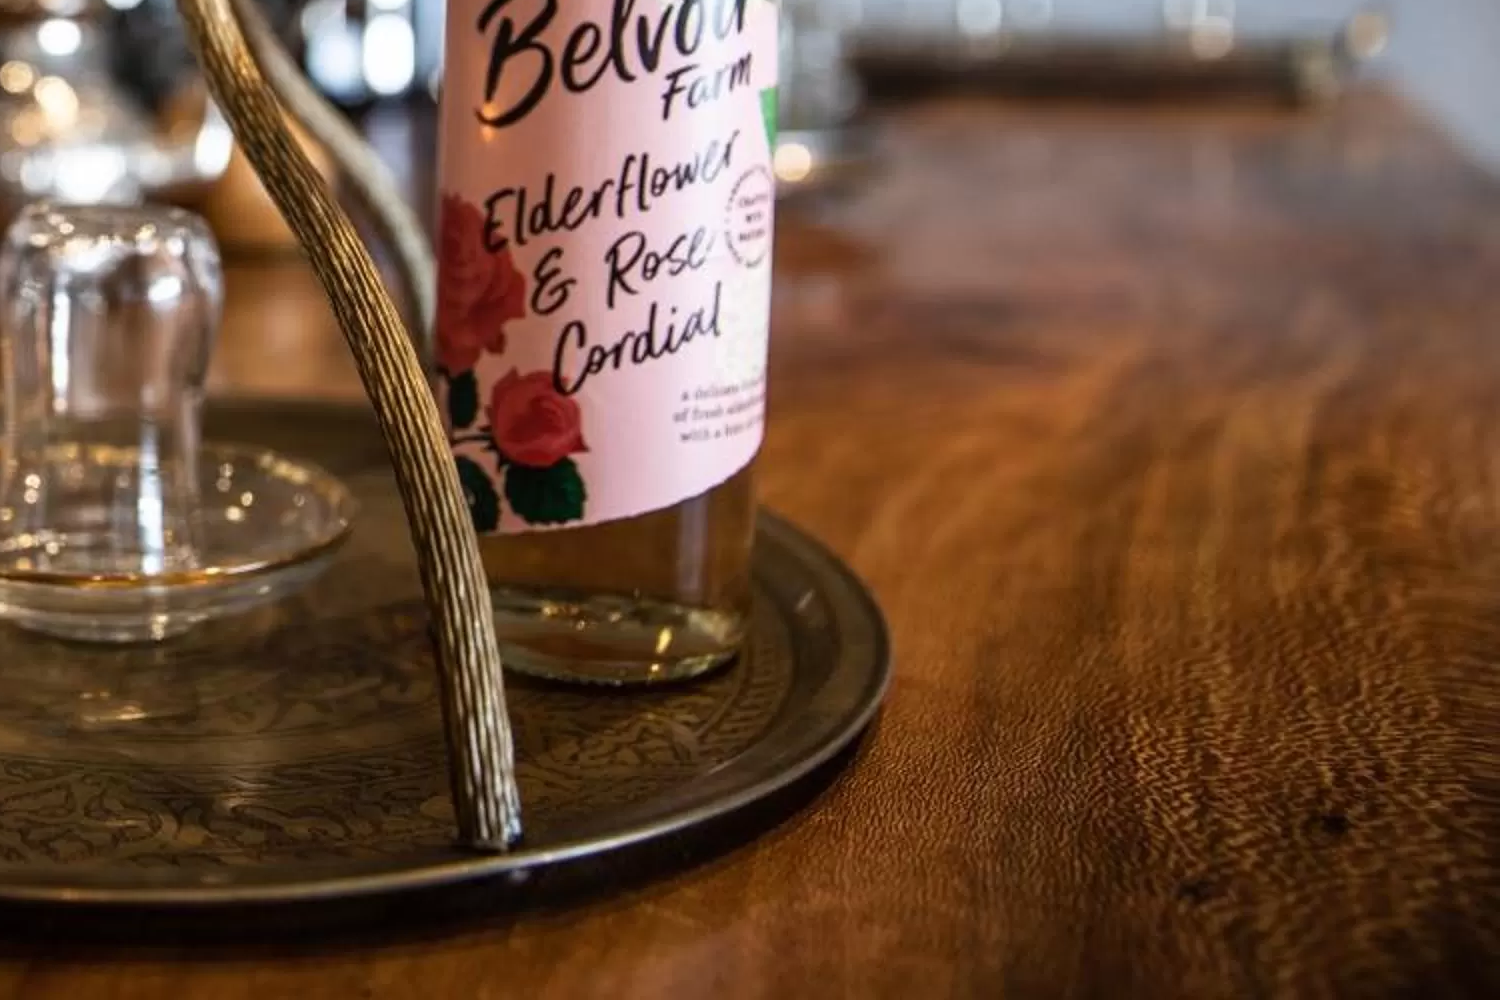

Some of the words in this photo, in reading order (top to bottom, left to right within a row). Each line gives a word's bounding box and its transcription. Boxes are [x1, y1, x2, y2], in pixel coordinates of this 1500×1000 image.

[661, 52, 752, 121] Farm
[482, 130, 740, 253] Elderflower
[531, 246, 578, 316] &
[604, 226, 716, 310] Rose
[551, 281, 722, 397] Cordial
